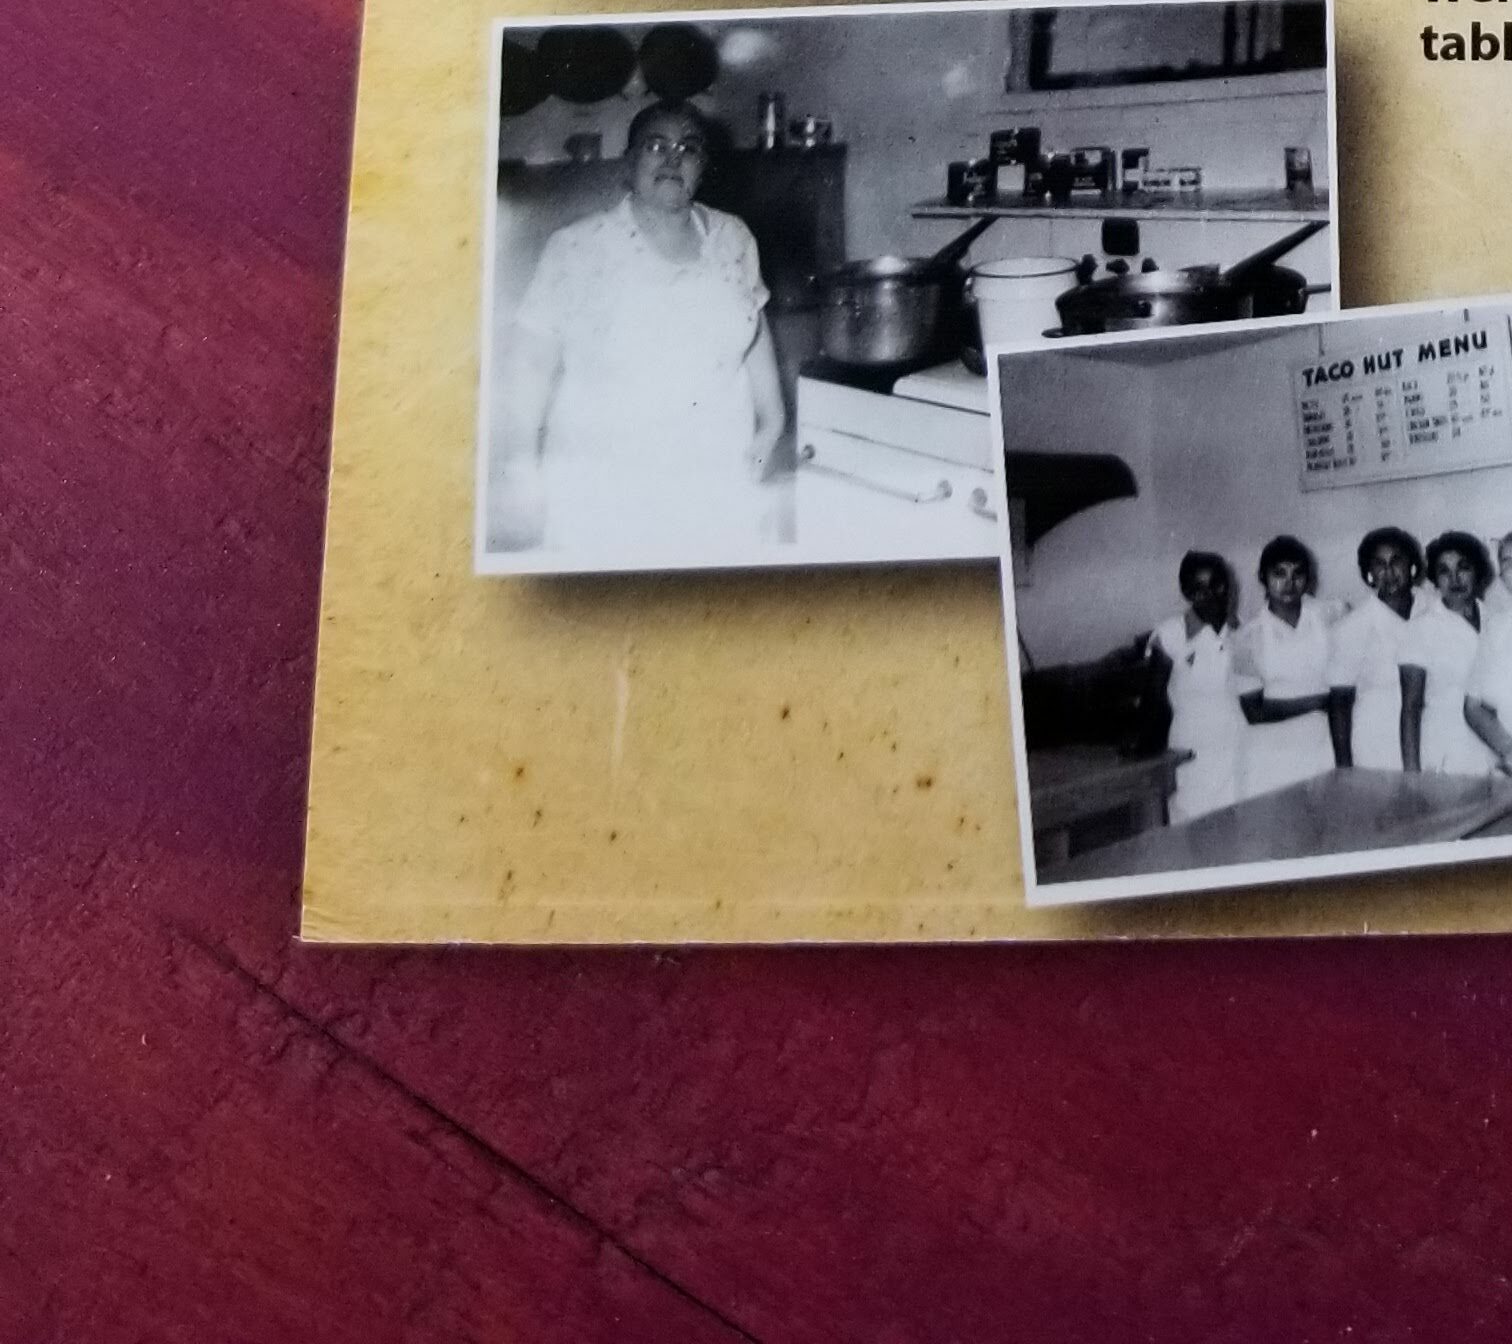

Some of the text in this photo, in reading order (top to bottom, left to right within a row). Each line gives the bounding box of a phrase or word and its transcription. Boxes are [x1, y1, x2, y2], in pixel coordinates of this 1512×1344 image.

[1303, 330, 1487, 387] TACO HUT MENU
